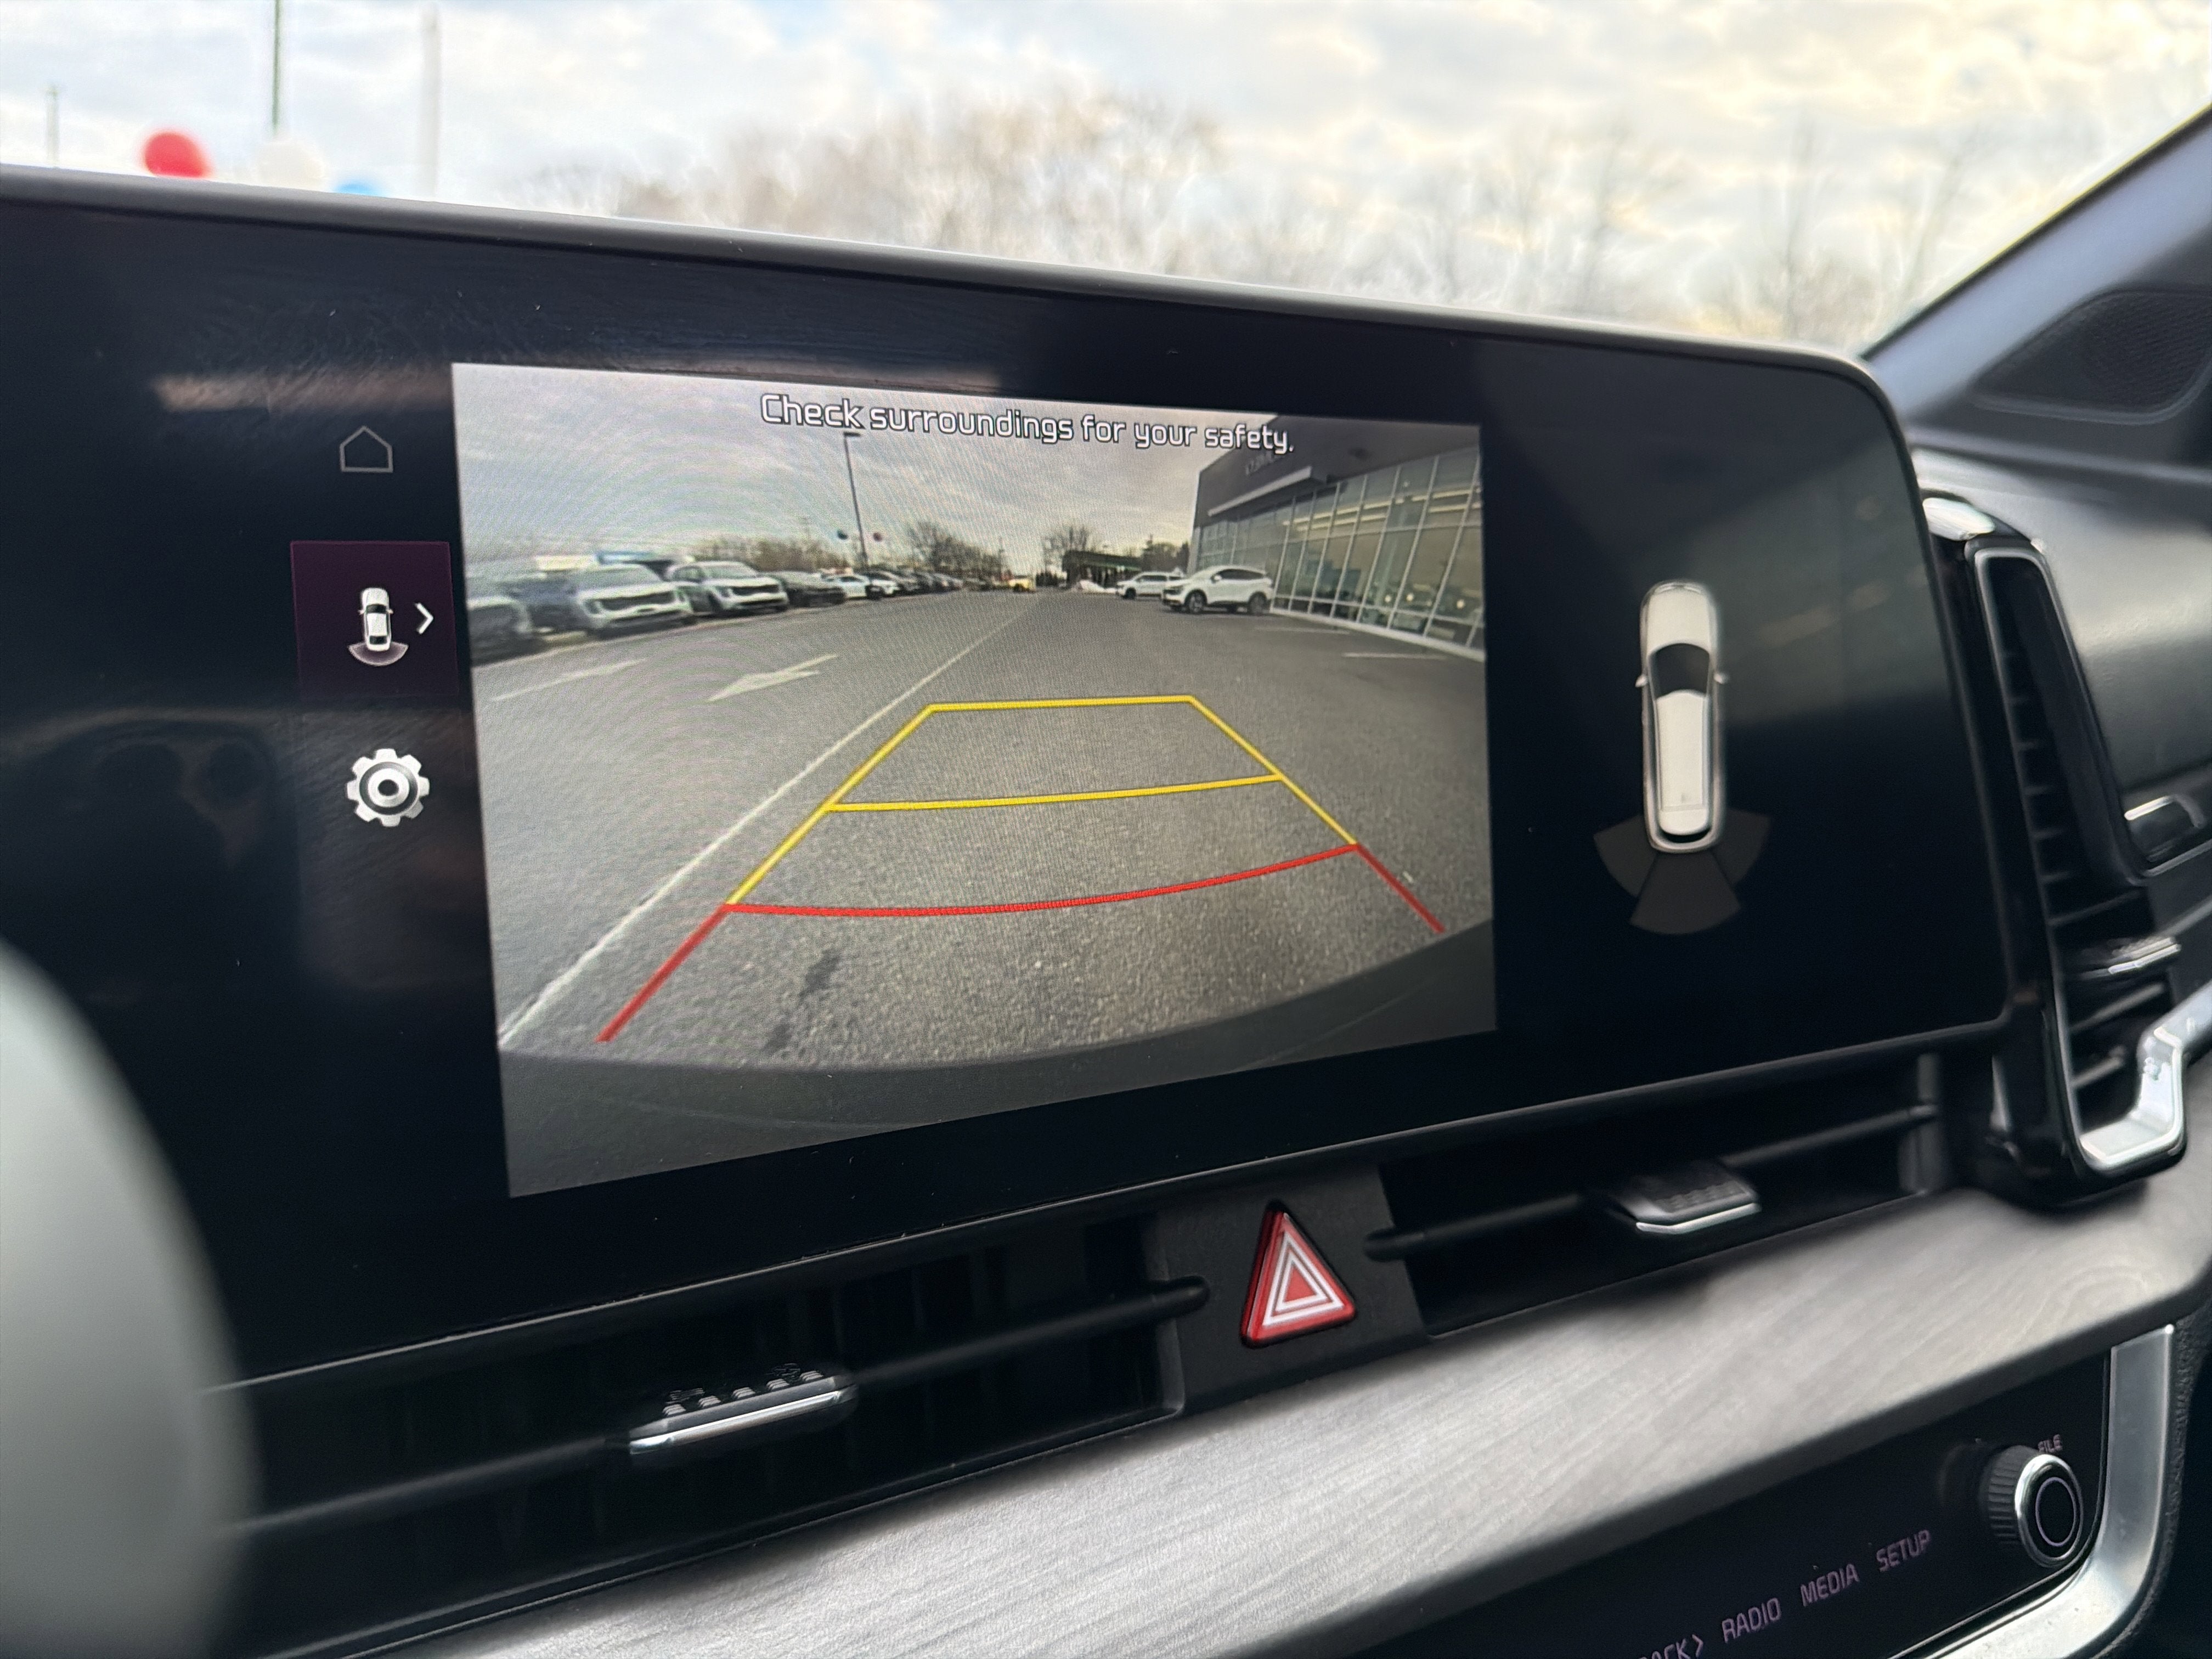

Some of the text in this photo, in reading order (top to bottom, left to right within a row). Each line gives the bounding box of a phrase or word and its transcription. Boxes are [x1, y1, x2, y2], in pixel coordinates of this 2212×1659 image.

[761, 393, 1295, 455] Check surroundings for your safety.
[1721, 1597, 1782, 1644] RADIO
[1800, 1563, 1860, 1607] MEDIA
[1876, 1529, 1931, 1573] SETUP
